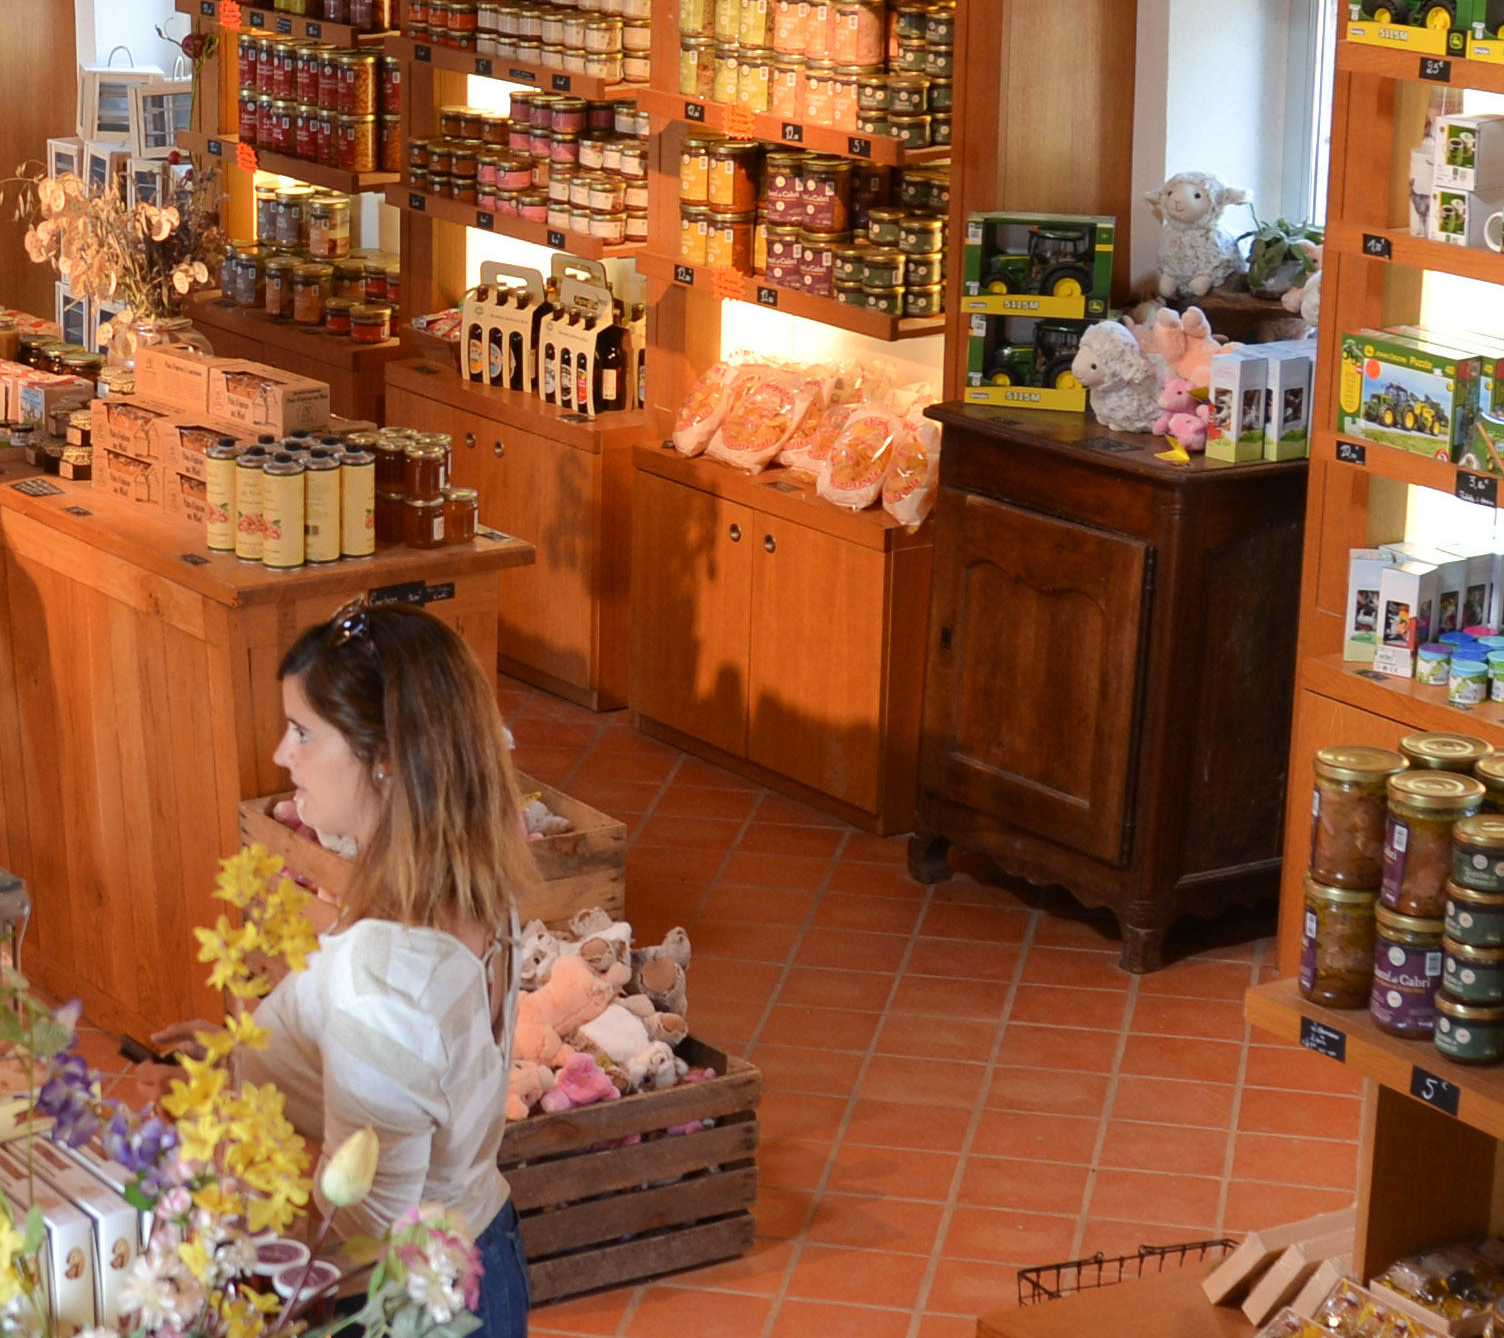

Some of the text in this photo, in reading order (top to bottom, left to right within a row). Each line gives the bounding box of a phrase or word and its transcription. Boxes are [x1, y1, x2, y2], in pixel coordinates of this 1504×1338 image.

[1379, 28, 1409, 42] 5115M
[1004, 299, 1039, 311] 5115M
[1409, 356, 1433, 370] Puzzle
[1005, 392, 1041, 403] 5115M
[1398, 973, 1432, 989] Cabri
